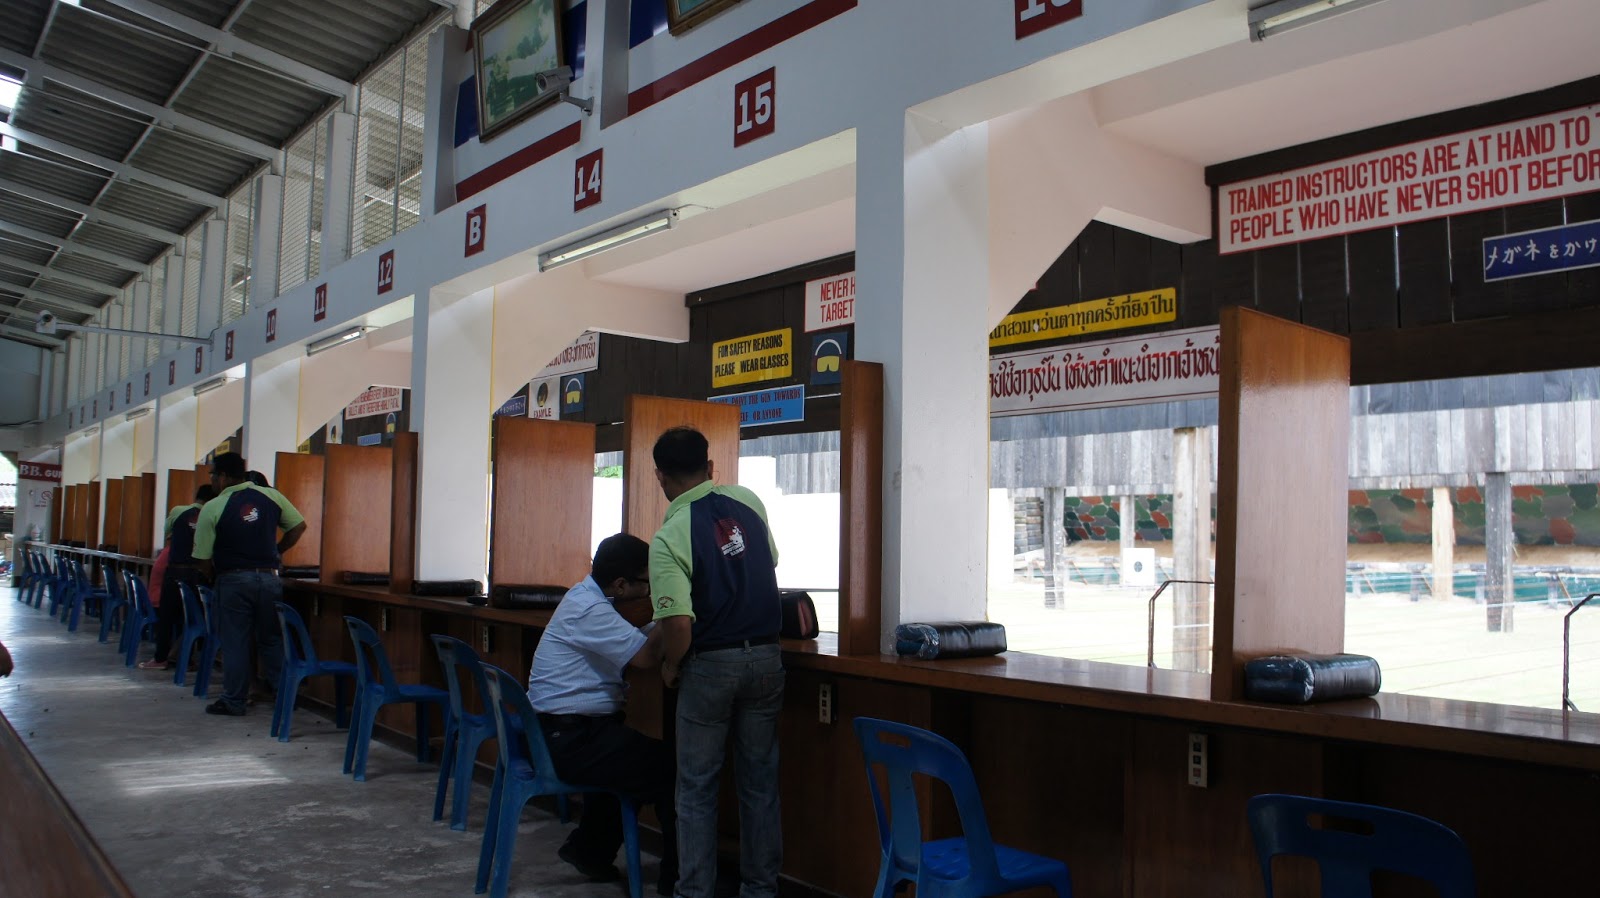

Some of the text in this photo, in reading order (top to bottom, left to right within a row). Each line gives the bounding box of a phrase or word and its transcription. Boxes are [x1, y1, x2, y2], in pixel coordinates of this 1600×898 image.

[736, 81, 772, 134] 15
[1228, 116, 1591, 216] TRAINED INSTRUCTORS ARE AT HAND TO
[575, 159, 601, 202] 14
[1230, 148, 1600, 245] PEOPLE WHO HAVE NEVER SHOT BEFOR
[469, 215, 481, 247] B
[378, 258, 392, 287] 12
[315, 290, 325, 315] 11
[820, 279, 849, 302] NEVER
[820, 299, 855, 323] TARGET
[717, 333, 783, 359] FOR SAFETY REASONS
[714, 353, 789, 378] PLEASE WEAR GLASSES
[761, 392, 771, 403] GUN
[774, 388, 801, 402] TOWARDS
